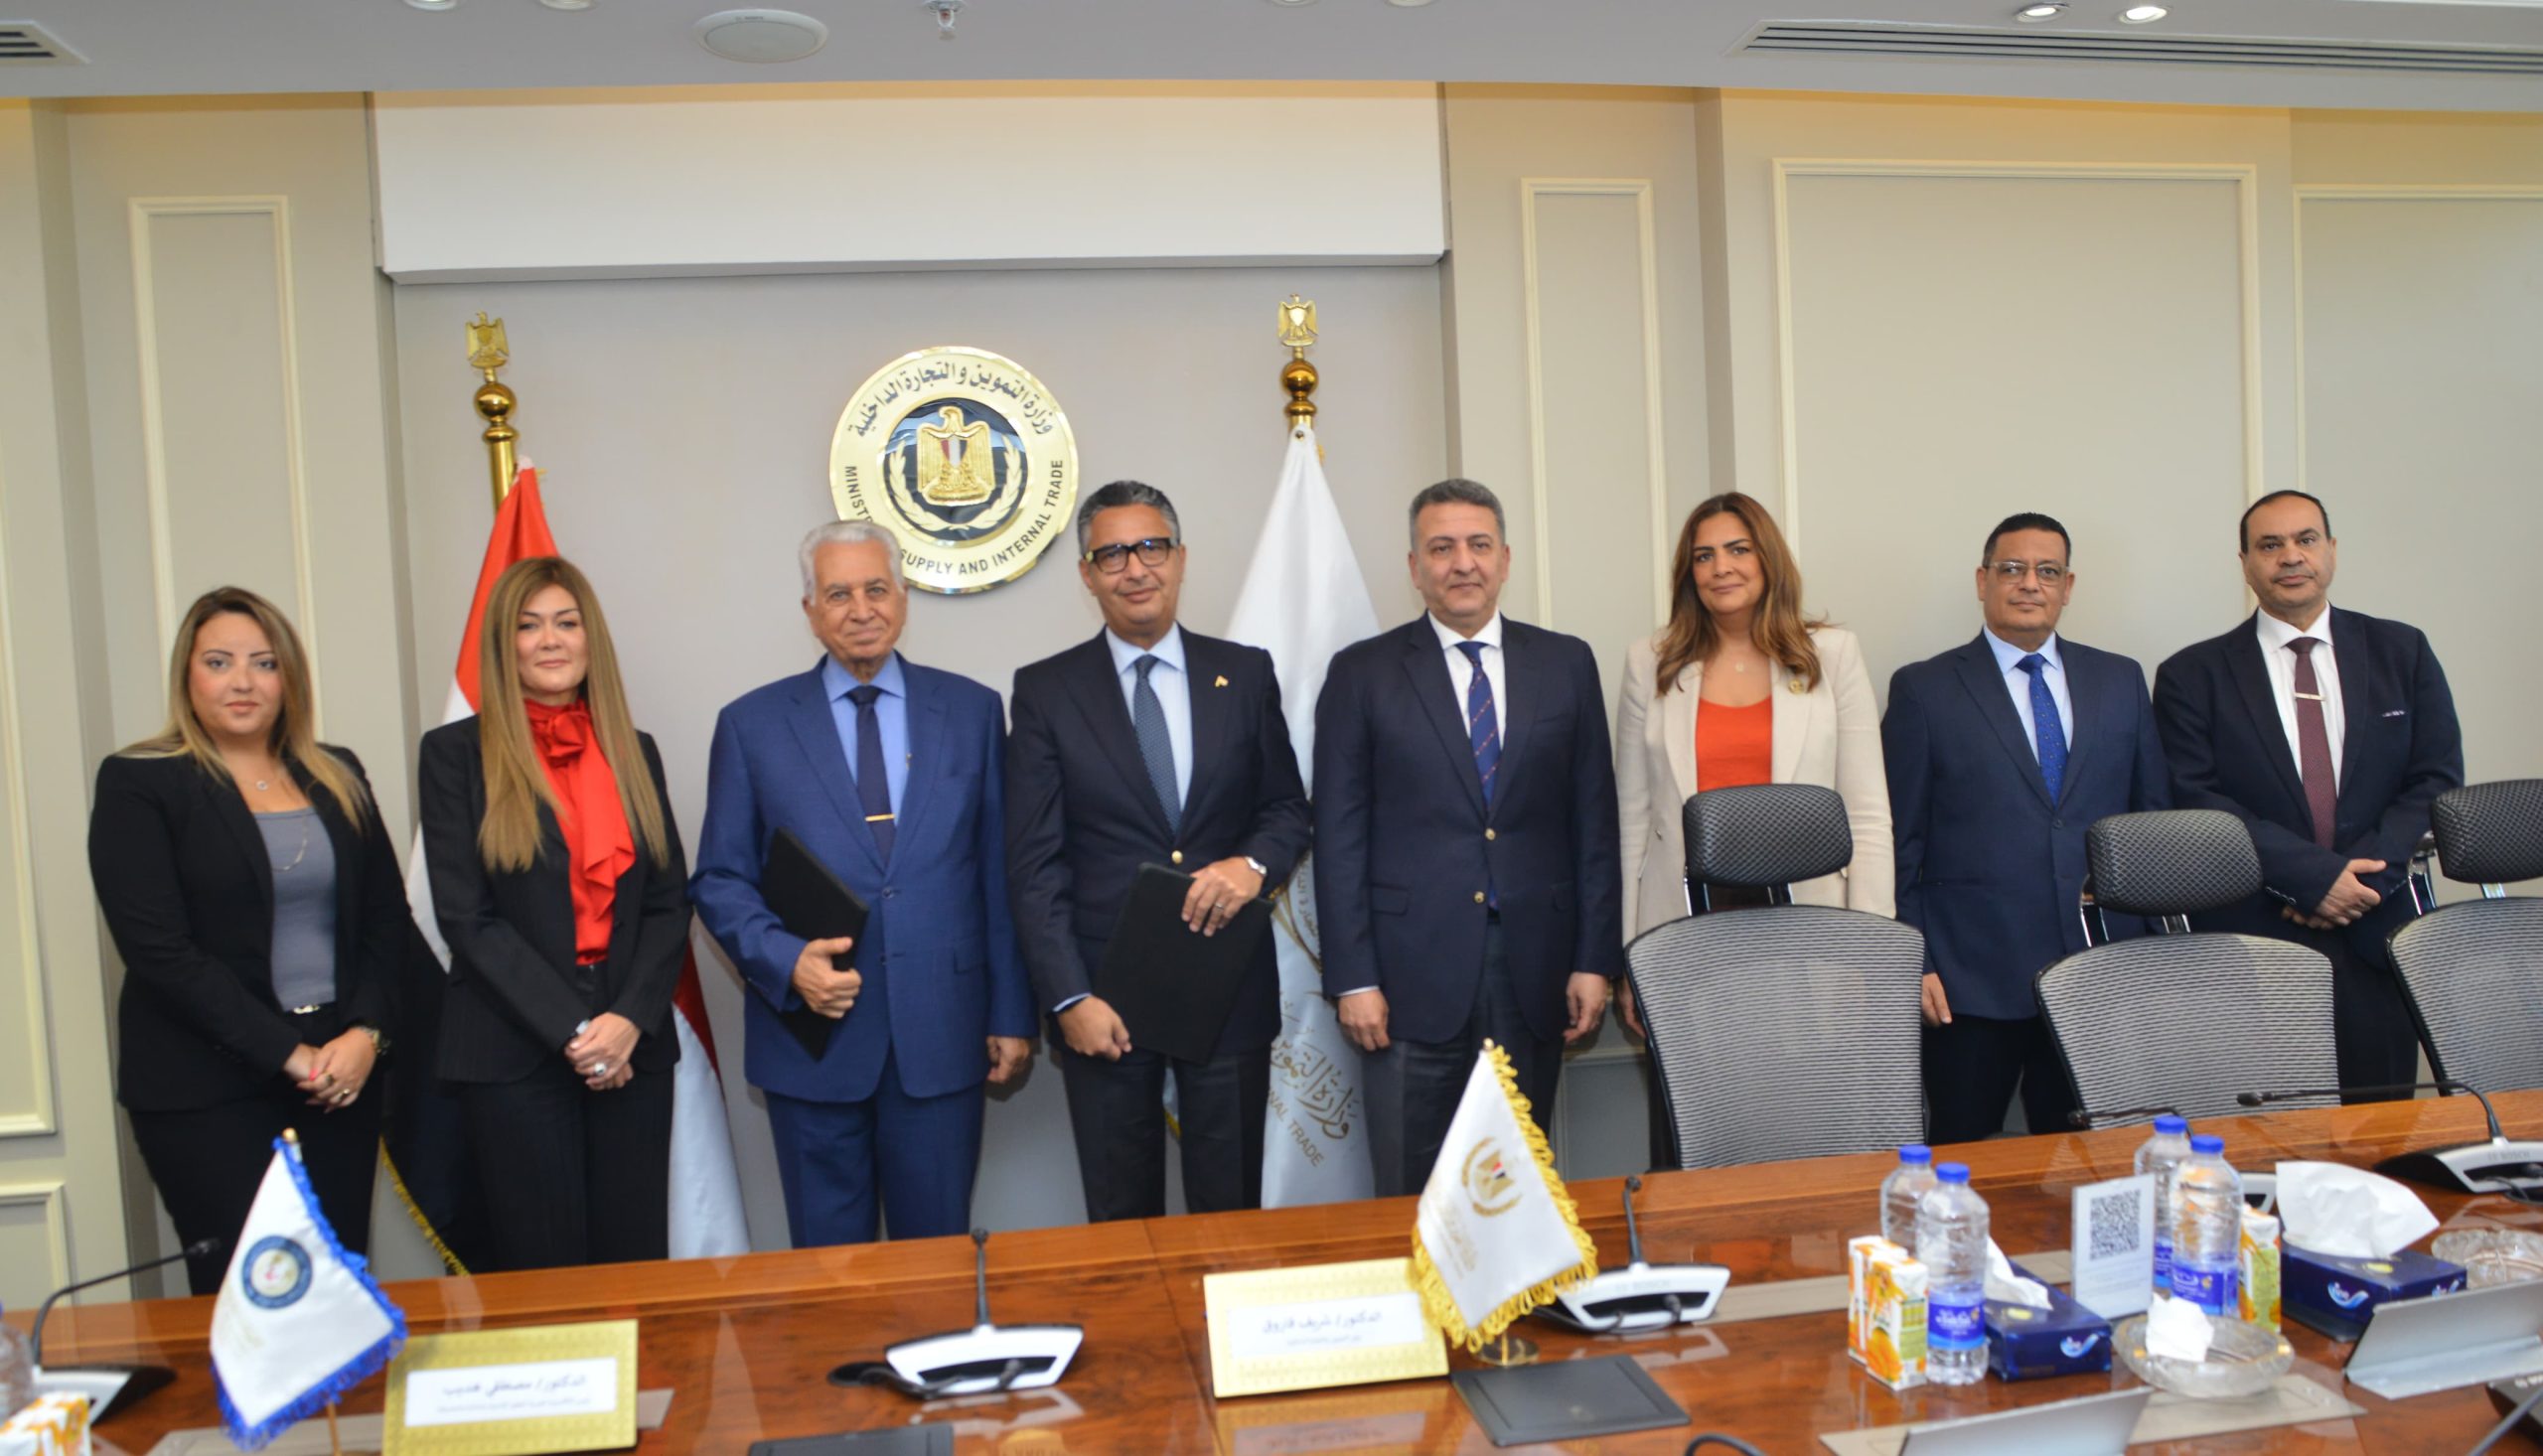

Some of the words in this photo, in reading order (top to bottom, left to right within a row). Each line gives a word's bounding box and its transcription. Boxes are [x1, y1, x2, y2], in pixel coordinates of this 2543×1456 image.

[901, 362, 967, 392] والتجارة
[970, 364, 1029, 402] التموين
[847, 379, 903, 437] الداخلية
[1023, 394, 1053, 435] وزارة
[844, 465, 874, 523] MINISTR
[900, 548, 954, 574] SUPPLY
[959, 558, 989, 575] AND
[992, 512, 1051, 567] INTERNAL
[1044, 460, 1064, 510] TRADE
[1289, 1118, 1324, 1167] TRADE
